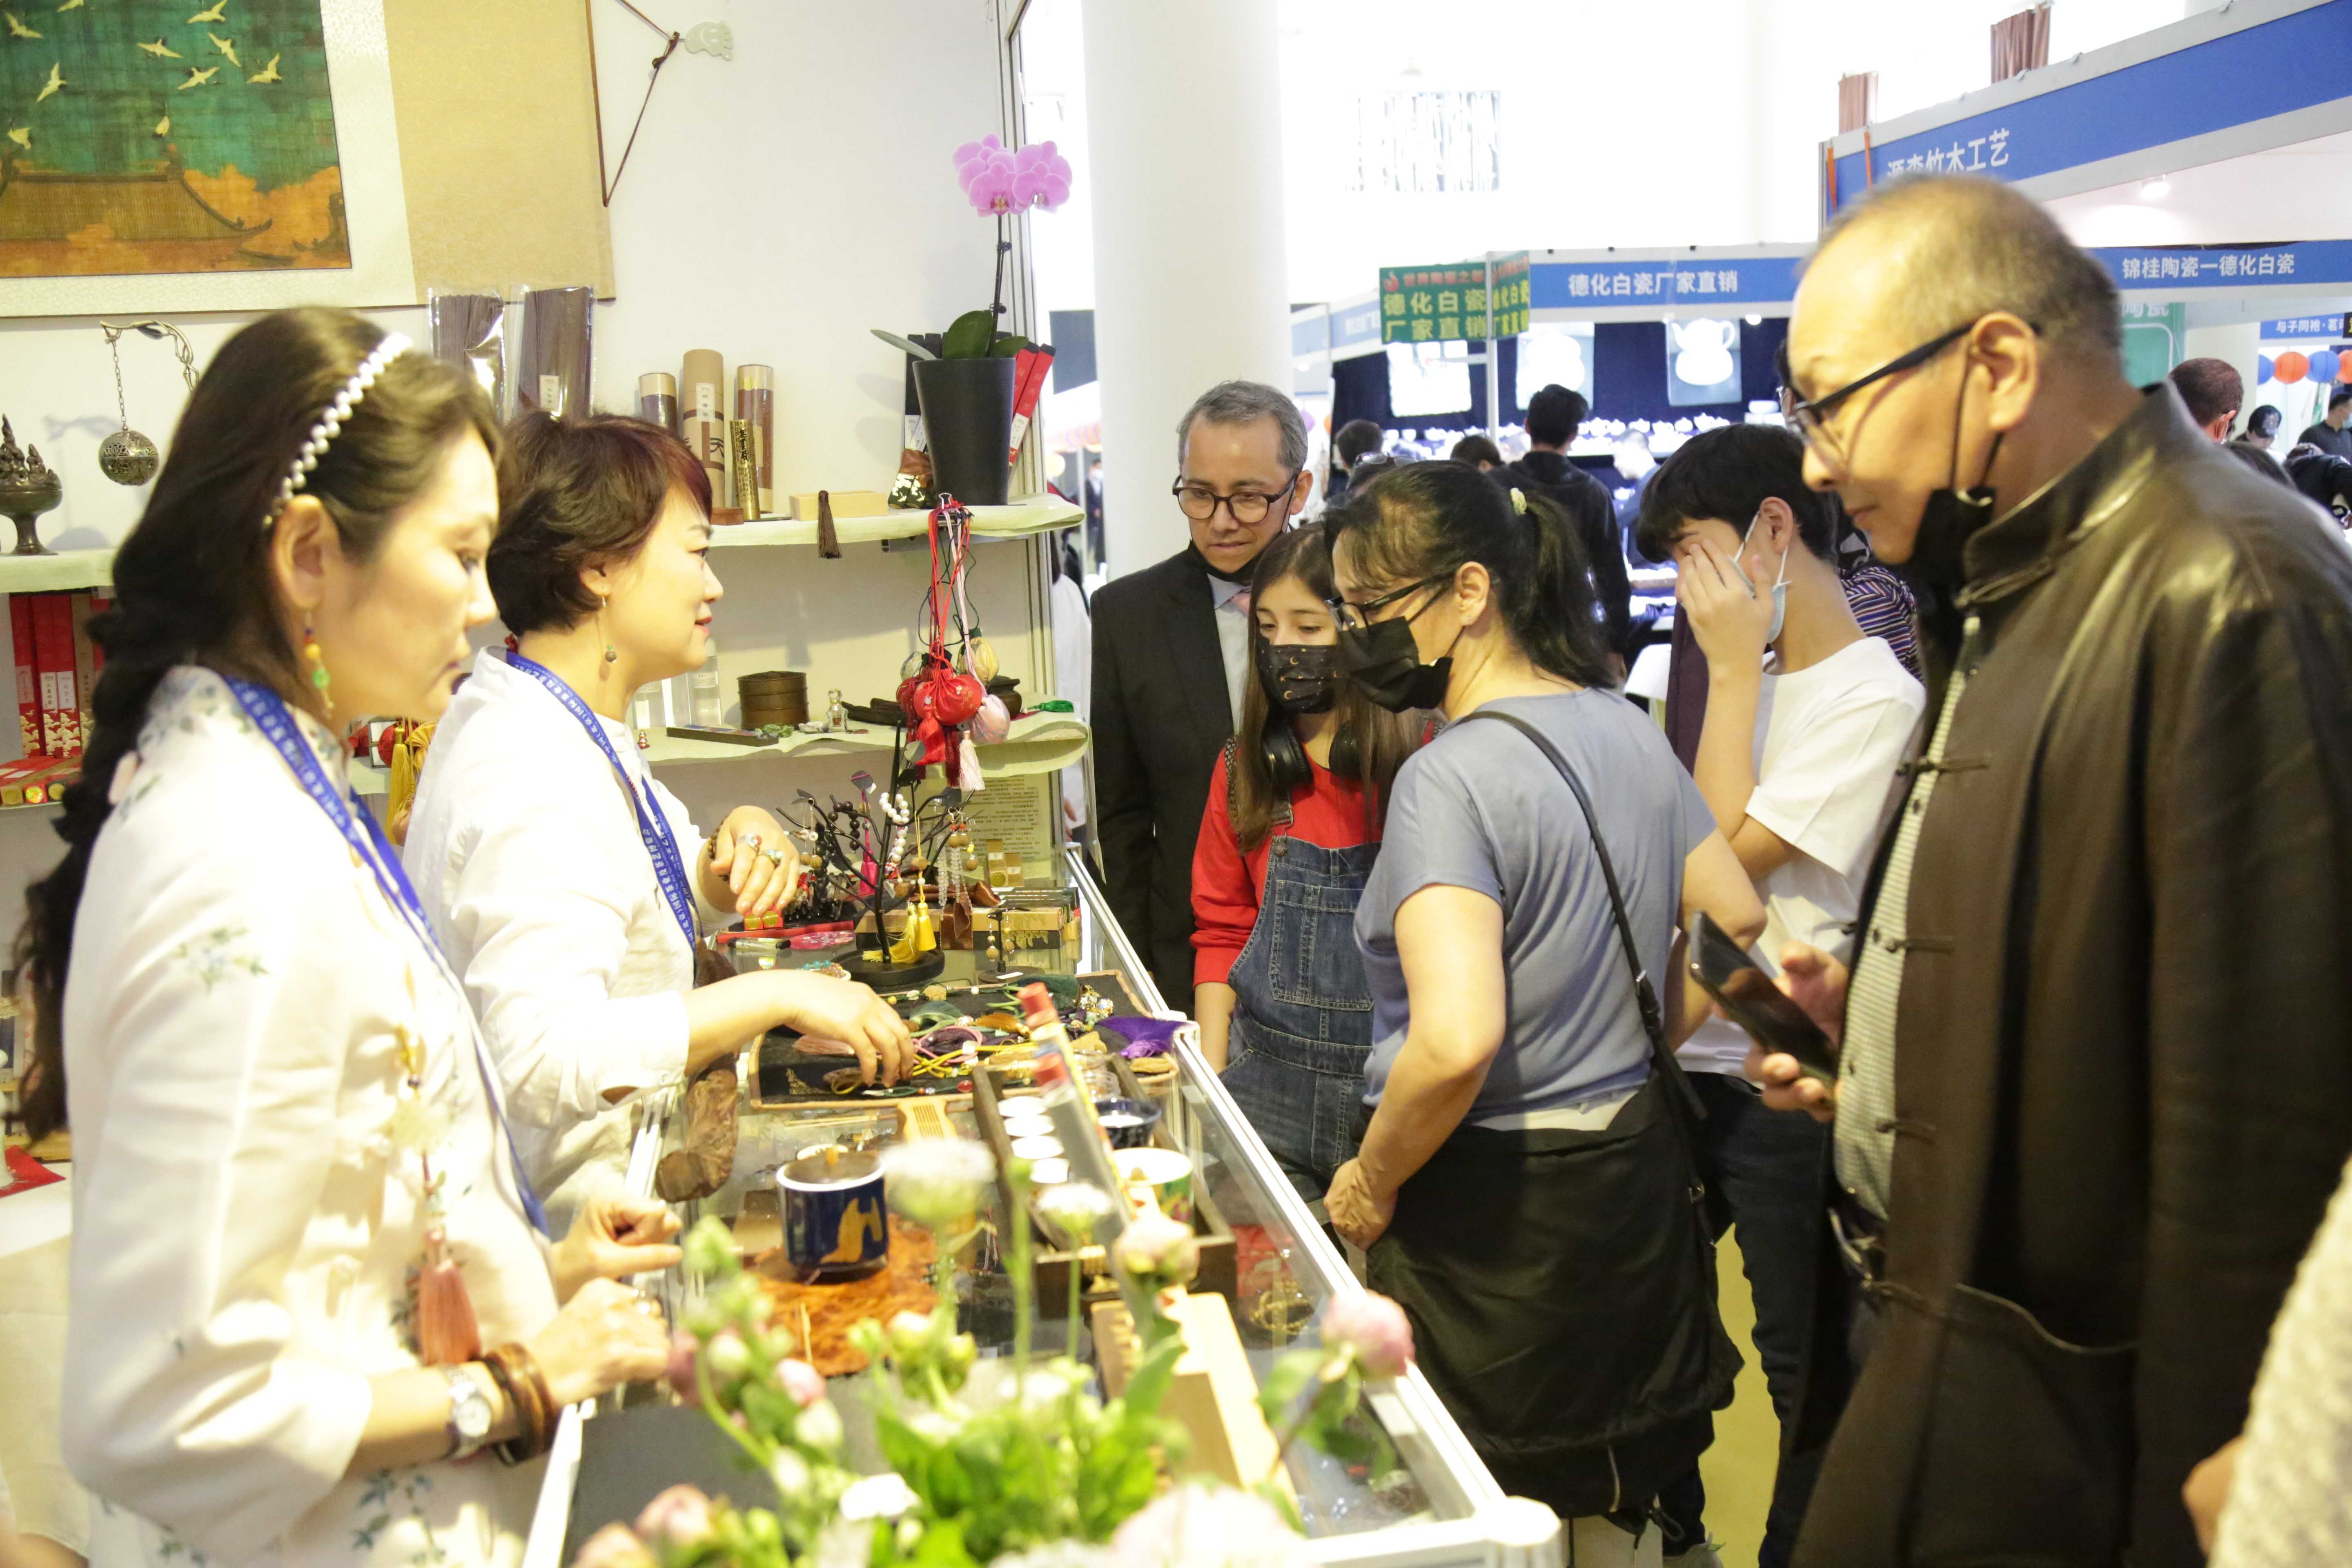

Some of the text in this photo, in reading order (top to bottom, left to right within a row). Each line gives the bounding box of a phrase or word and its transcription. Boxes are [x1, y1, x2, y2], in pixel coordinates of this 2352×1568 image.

[1568, 270, 1738, 297] 德化白瓷厂家直销
[1384, 289, 1486, 316] 德化白瓷
[1385, 315, 1487, 342] 厂家直销
